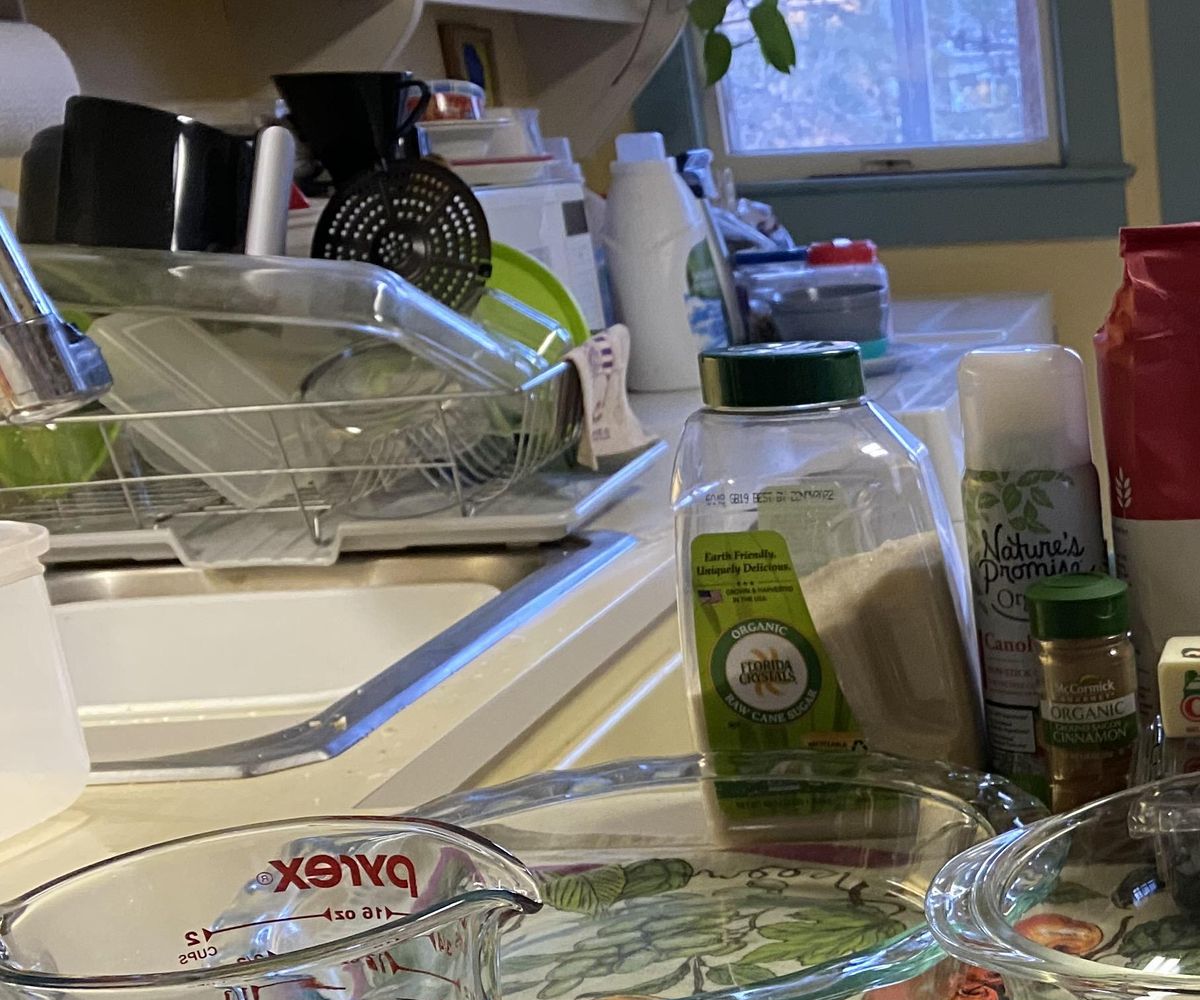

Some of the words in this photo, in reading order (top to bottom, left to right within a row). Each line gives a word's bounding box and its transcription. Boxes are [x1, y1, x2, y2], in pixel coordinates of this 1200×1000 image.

[981, 523, 1085, 562] Nature's
[704, 551, 731, 562] Earth
[696, 563, 741, 577] Uniquely
[731, 621, 788, 640] ORGANIC
[984, 631, 1033, 652] Canol
[740, 659, 793, 674] FLORIDA
[739, 671, 797, 685] CRYSTALS
[724, 693, 750, 716] RAW
[752, 712, 787, 724] CANE
[788, 688, 819, 719] SUGAR
[1050, 701, 1126, 721] ORGANIC
[1052, 728, 1127, 743] CINNAMON
